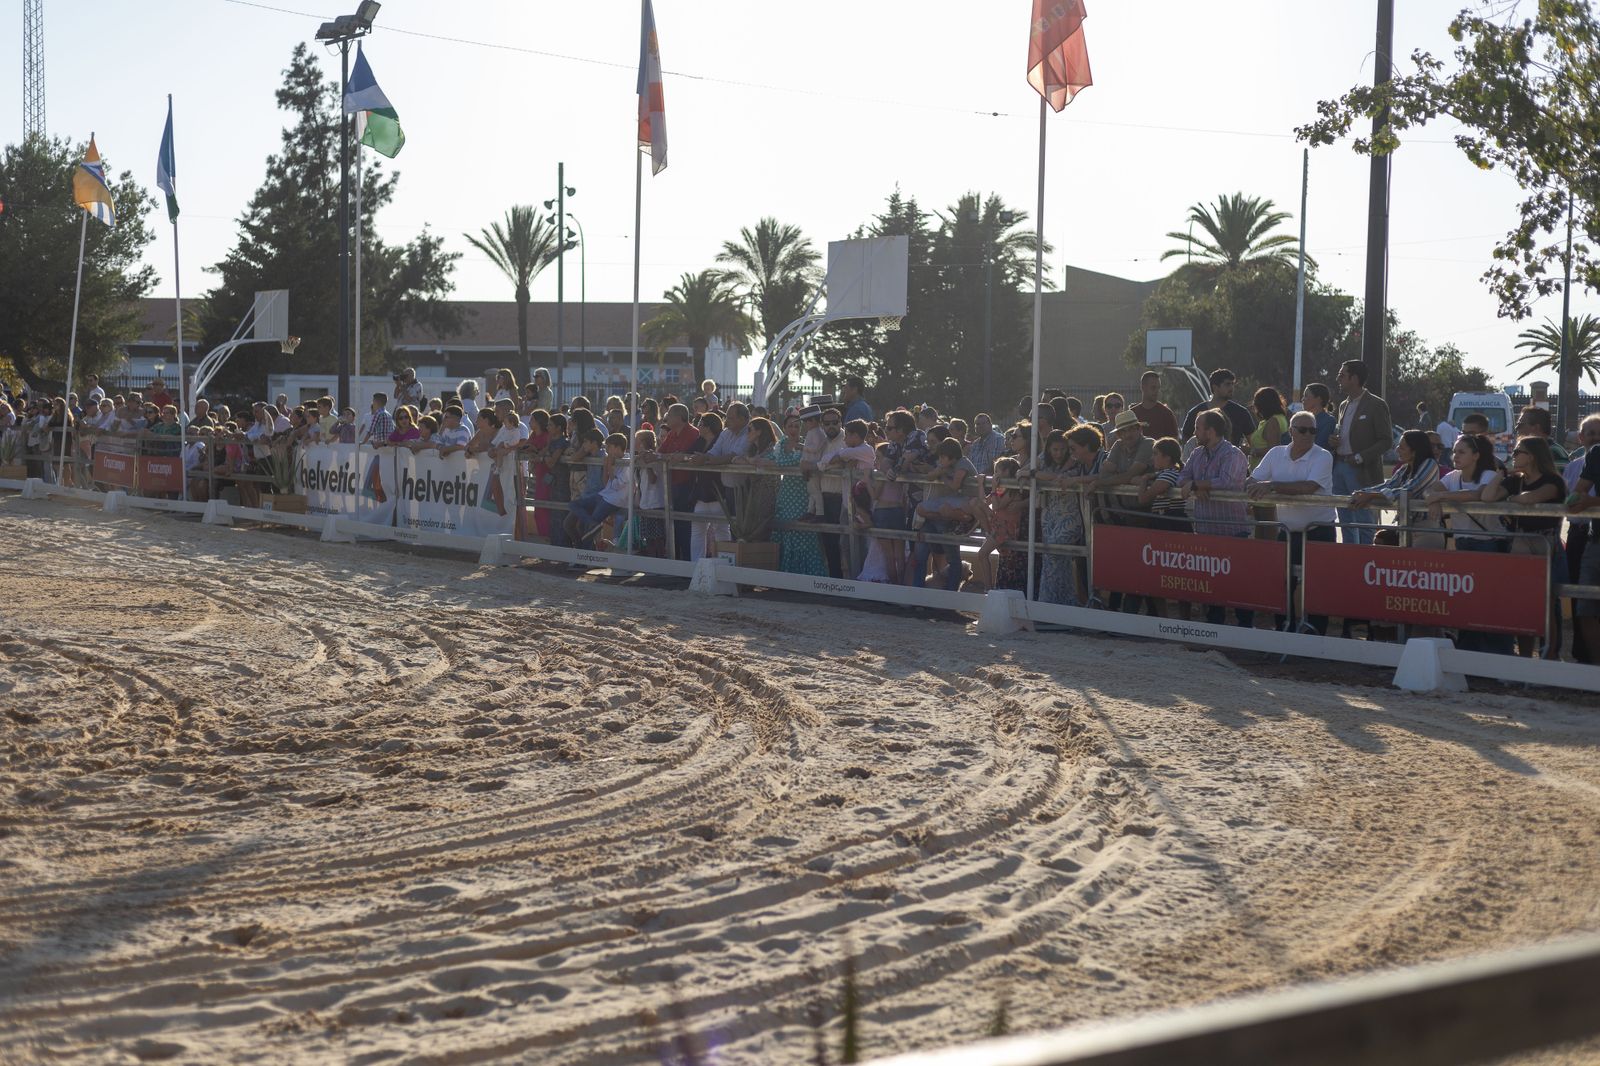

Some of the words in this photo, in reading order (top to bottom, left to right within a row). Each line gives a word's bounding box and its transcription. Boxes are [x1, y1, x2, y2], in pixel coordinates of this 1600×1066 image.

[402, 468, 479, 507] helvetia
[1142, 544, 1232, 577] Cruzcampo
[1160, 575, 1213, 593] ESPECIAL
[1363, 560, 1475, 597] Cruzcampo
[1386, 596, 1450, 615] ESPECIAL
[1159, 624, 1218, 639] tonohipica.com
